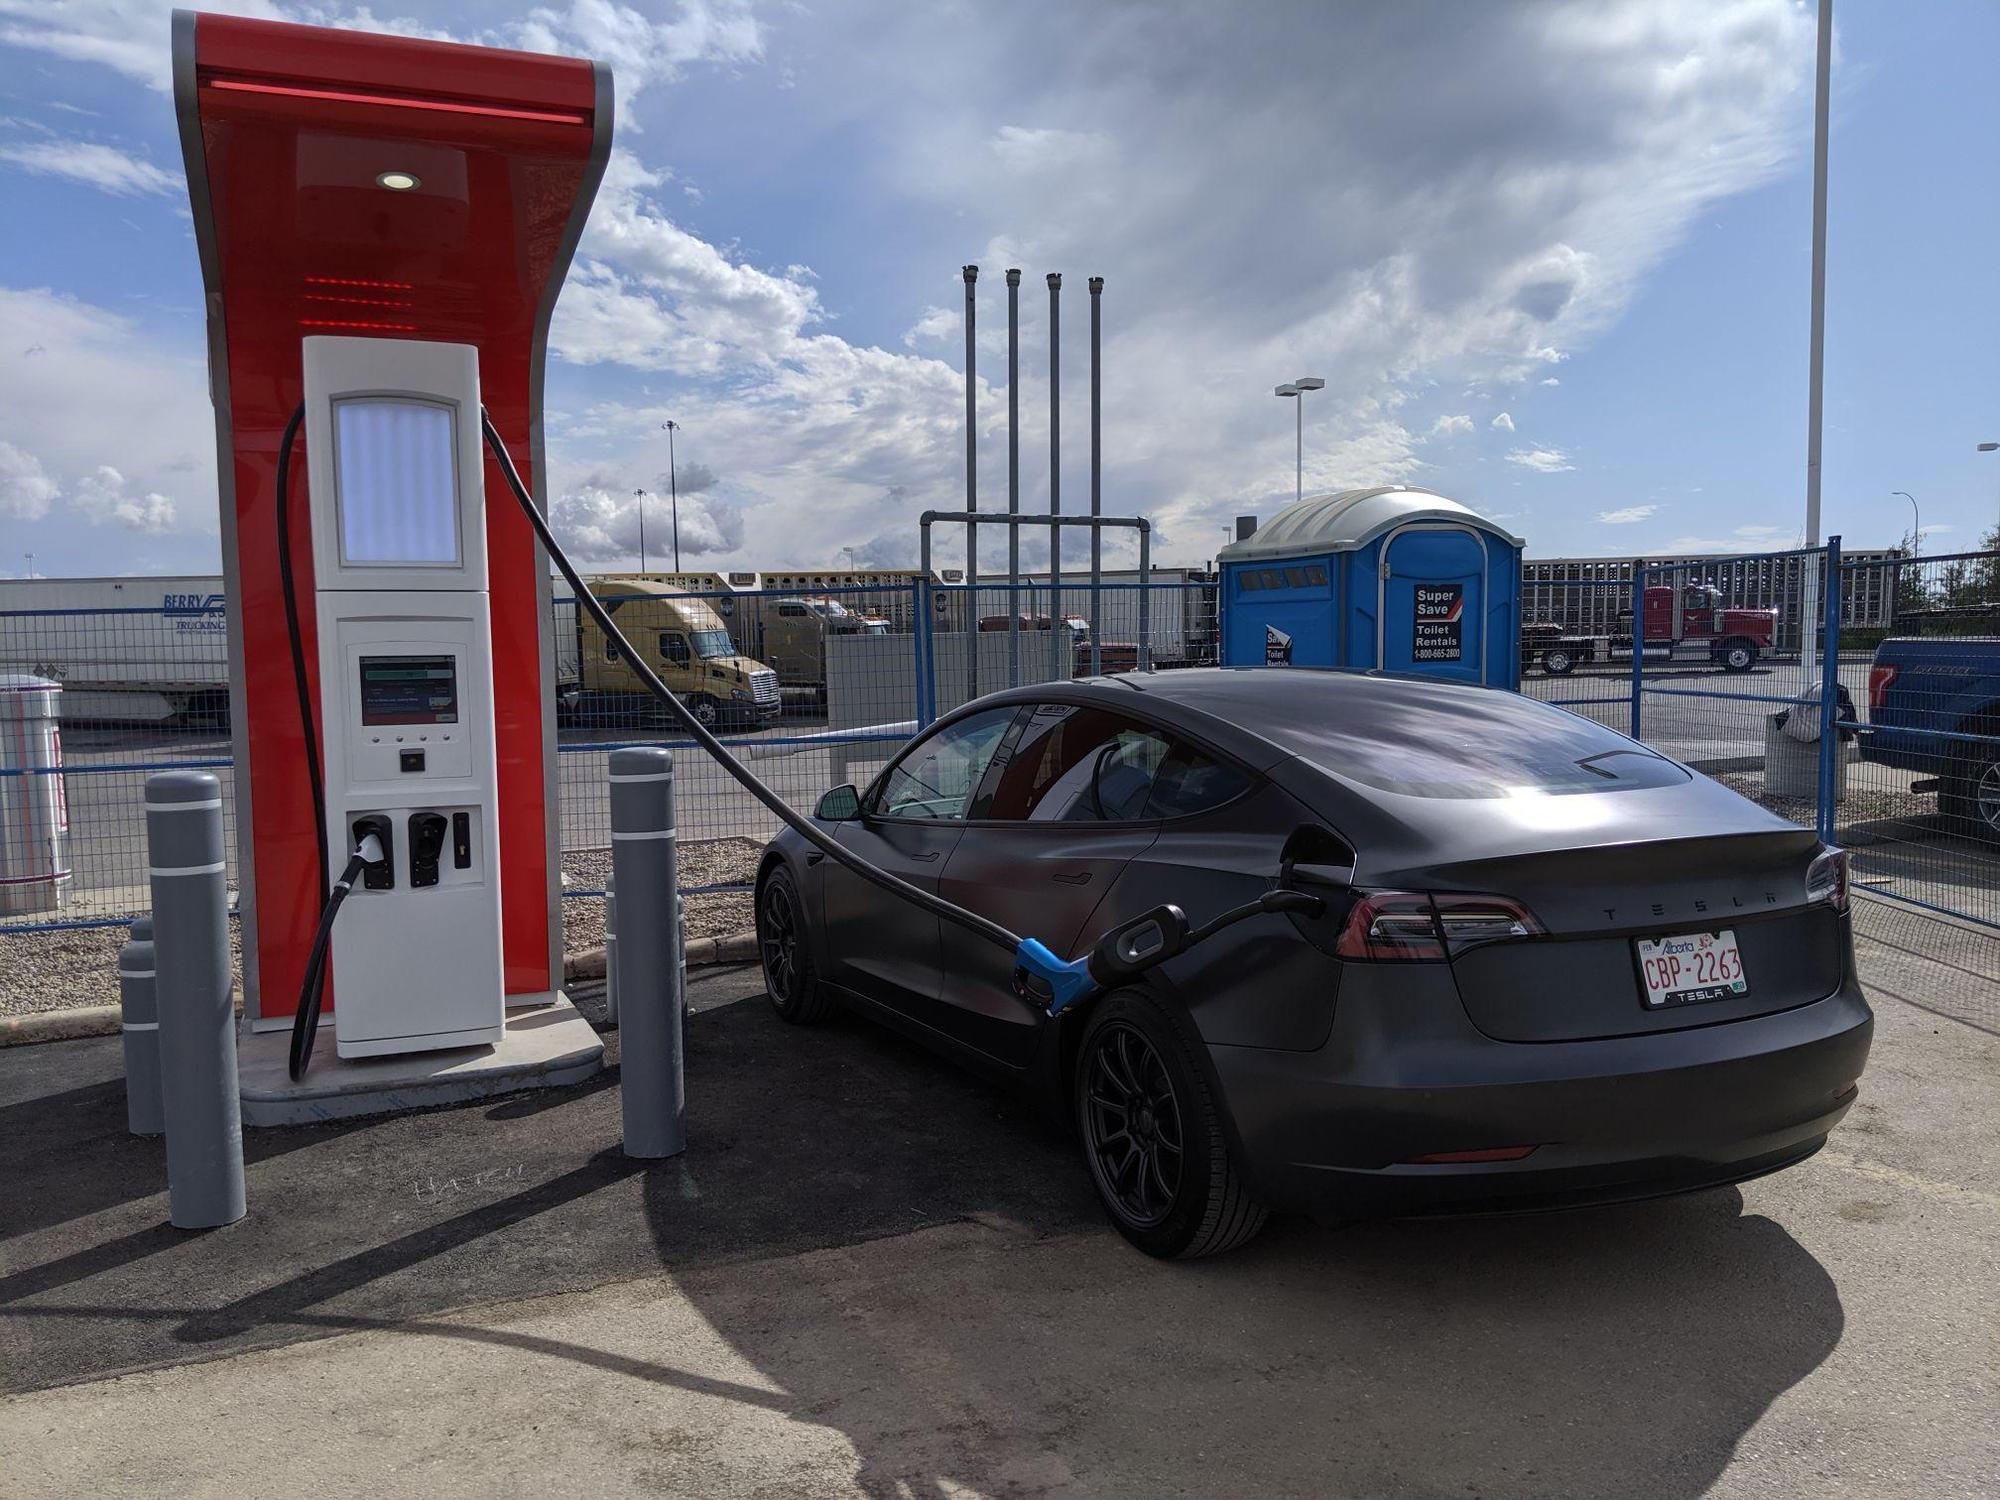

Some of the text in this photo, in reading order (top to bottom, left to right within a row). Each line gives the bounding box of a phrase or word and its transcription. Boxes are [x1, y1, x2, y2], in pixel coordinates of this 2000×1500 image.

[164, 594, 203, 609] BERRY
[1417, 590, 1454, 603] Super
[1417, 603, 1448, 615] Save
[176, 621, 225, 630] TRUCKING
[1416, 625, 1449, 635] Toilet
[1416, 637, 1457, 646] Rentals
[1414, 648, 1460, 659] 1-800-665-2800
[1603, 892, 1776, 921] TESLA
[1662, 939, 1694, 955] Alberta
[1645, 948, 1741, 990] CBP-2263
[1677, 988, 1724, 1002] TESLA
